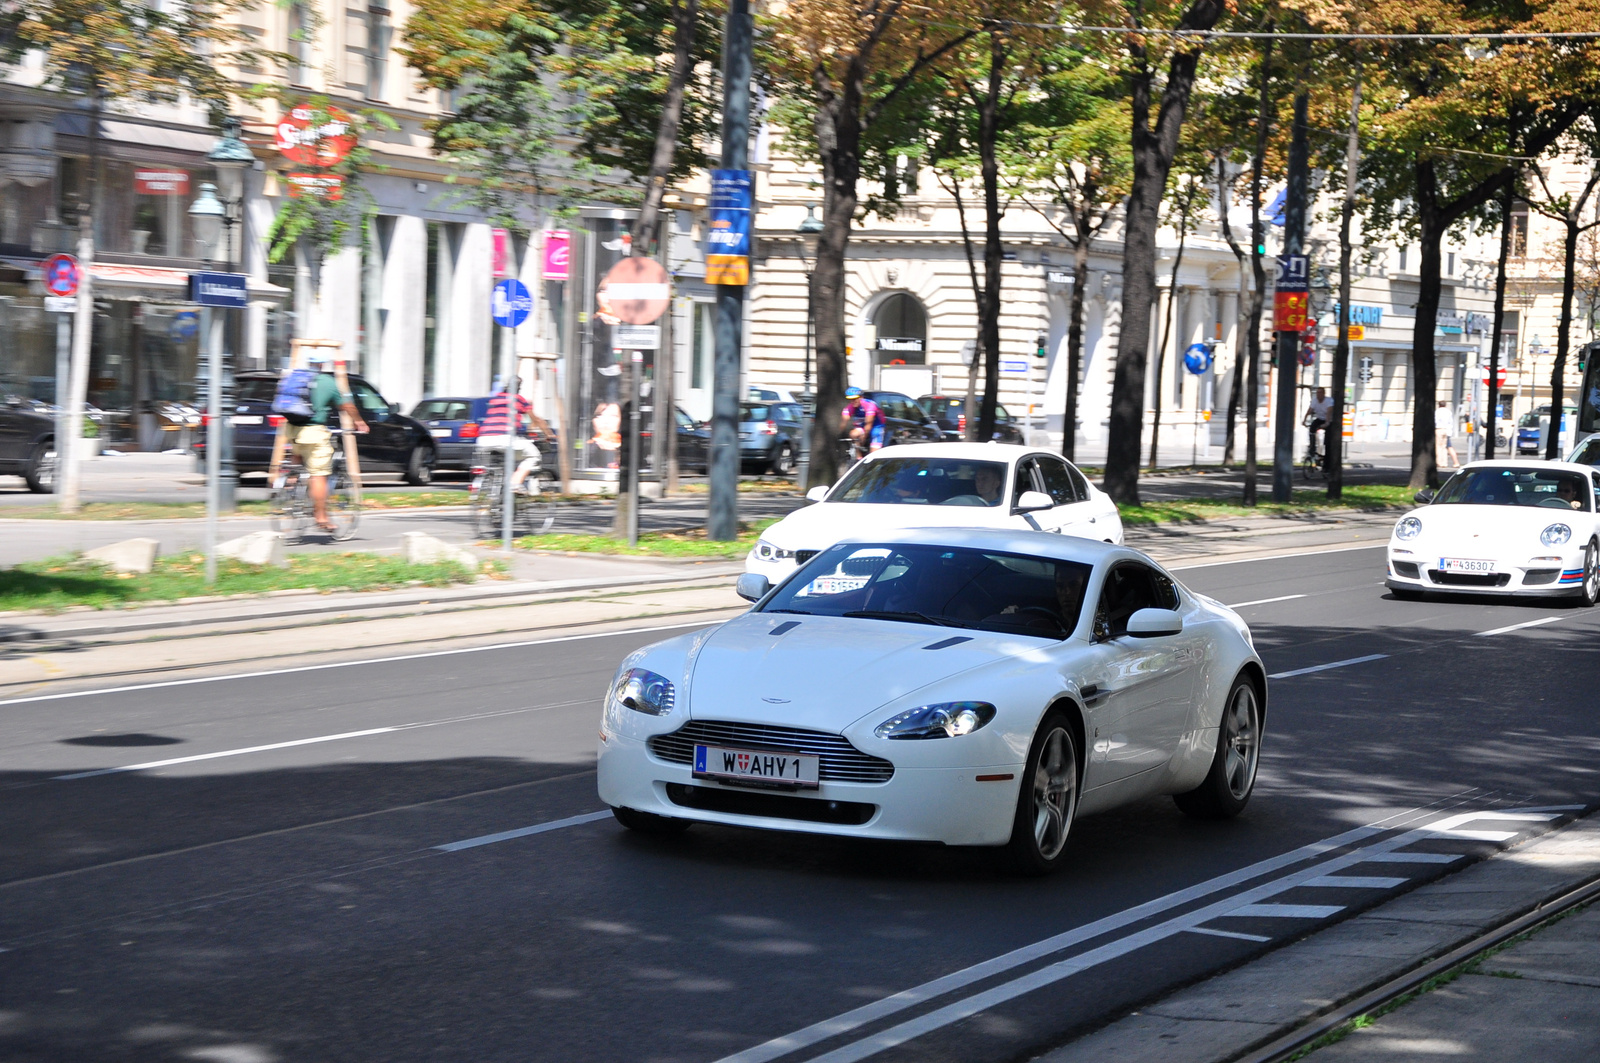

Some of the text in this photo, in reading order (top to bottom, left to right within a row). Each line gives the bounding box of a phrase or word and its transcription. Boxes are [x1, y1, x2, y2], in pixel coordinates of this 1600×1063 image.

[1340, 304, 1383, 324] EGWAY
[1446, 560, 1495, 571] W 43630 Z
[723, 752, 800, 778] W AHV 1
